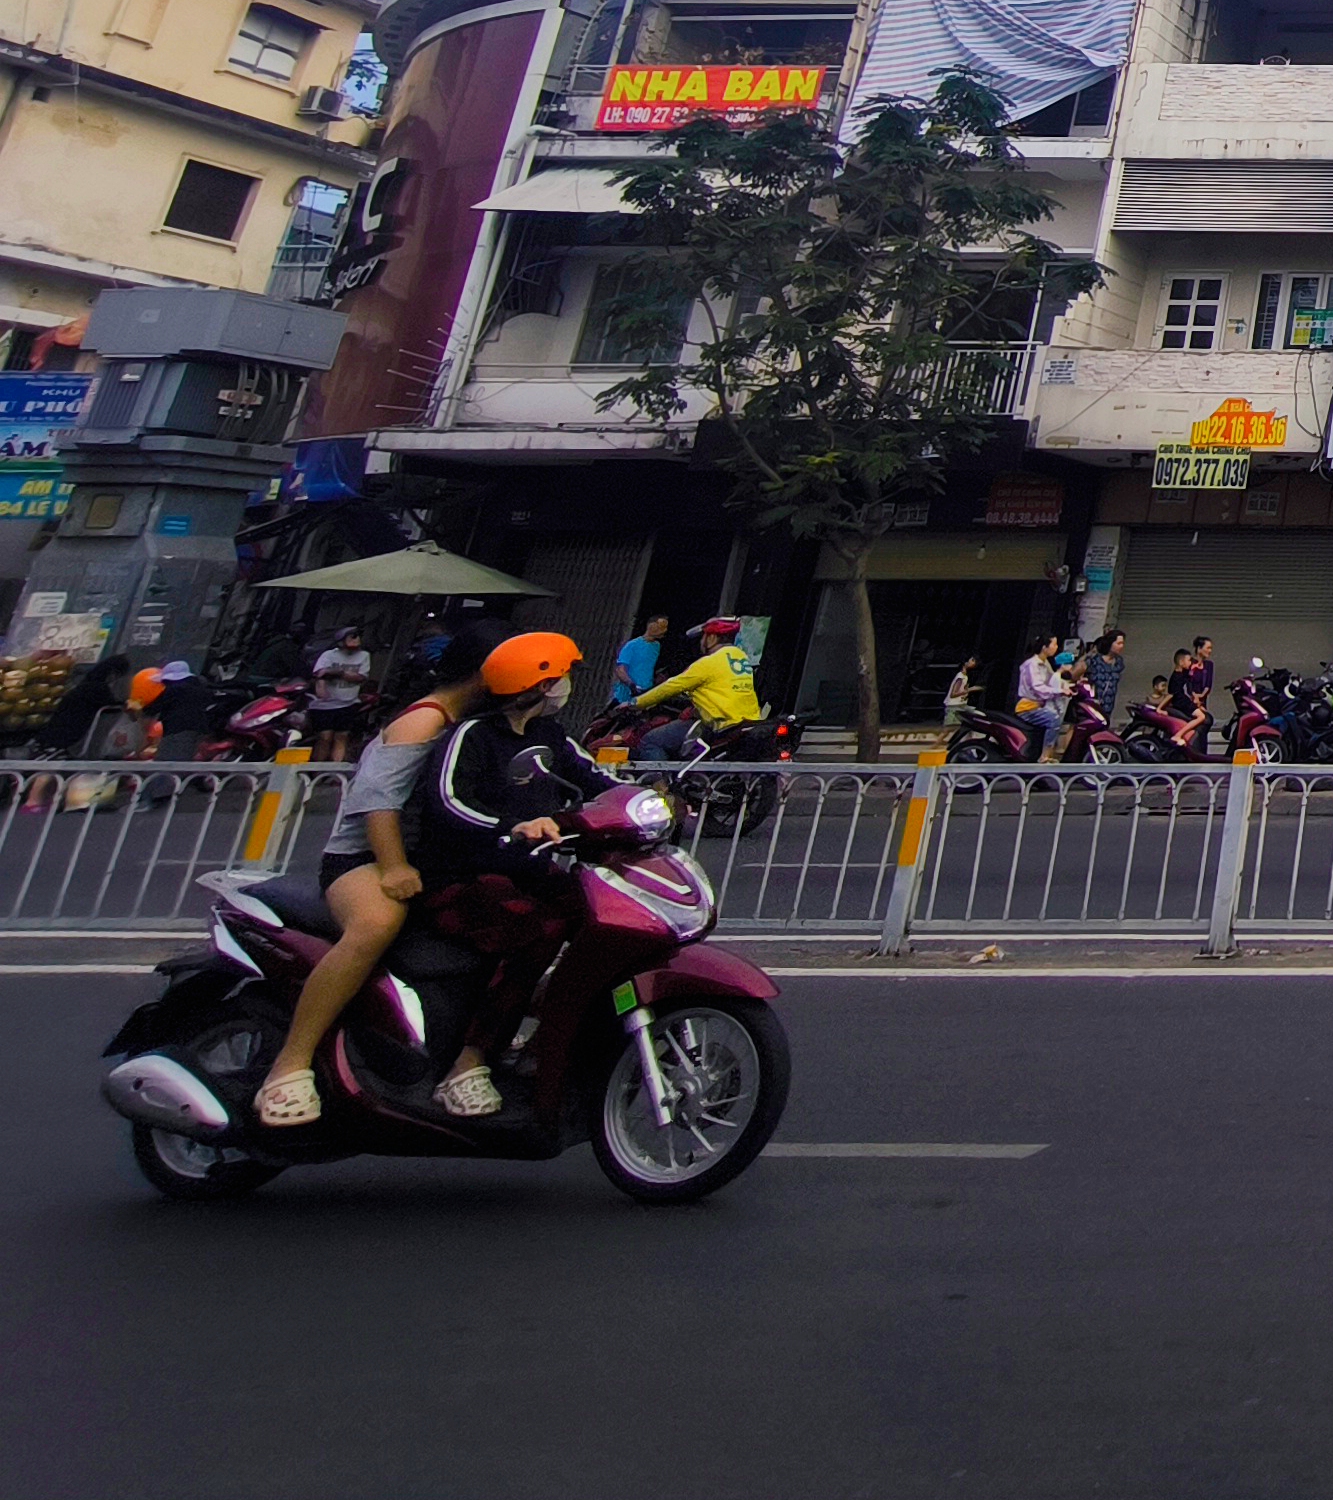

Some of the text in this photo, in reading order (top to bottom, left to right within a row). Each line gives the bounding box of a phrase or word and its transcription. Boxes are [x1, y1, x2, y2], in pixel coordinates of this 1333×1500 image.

[603, 107, 624, 124] LH:
[626, 107, 649, 123] 090
[652, 107, 670, 123] 27
[1155, 457, 1249, 487] 0972.377.039
